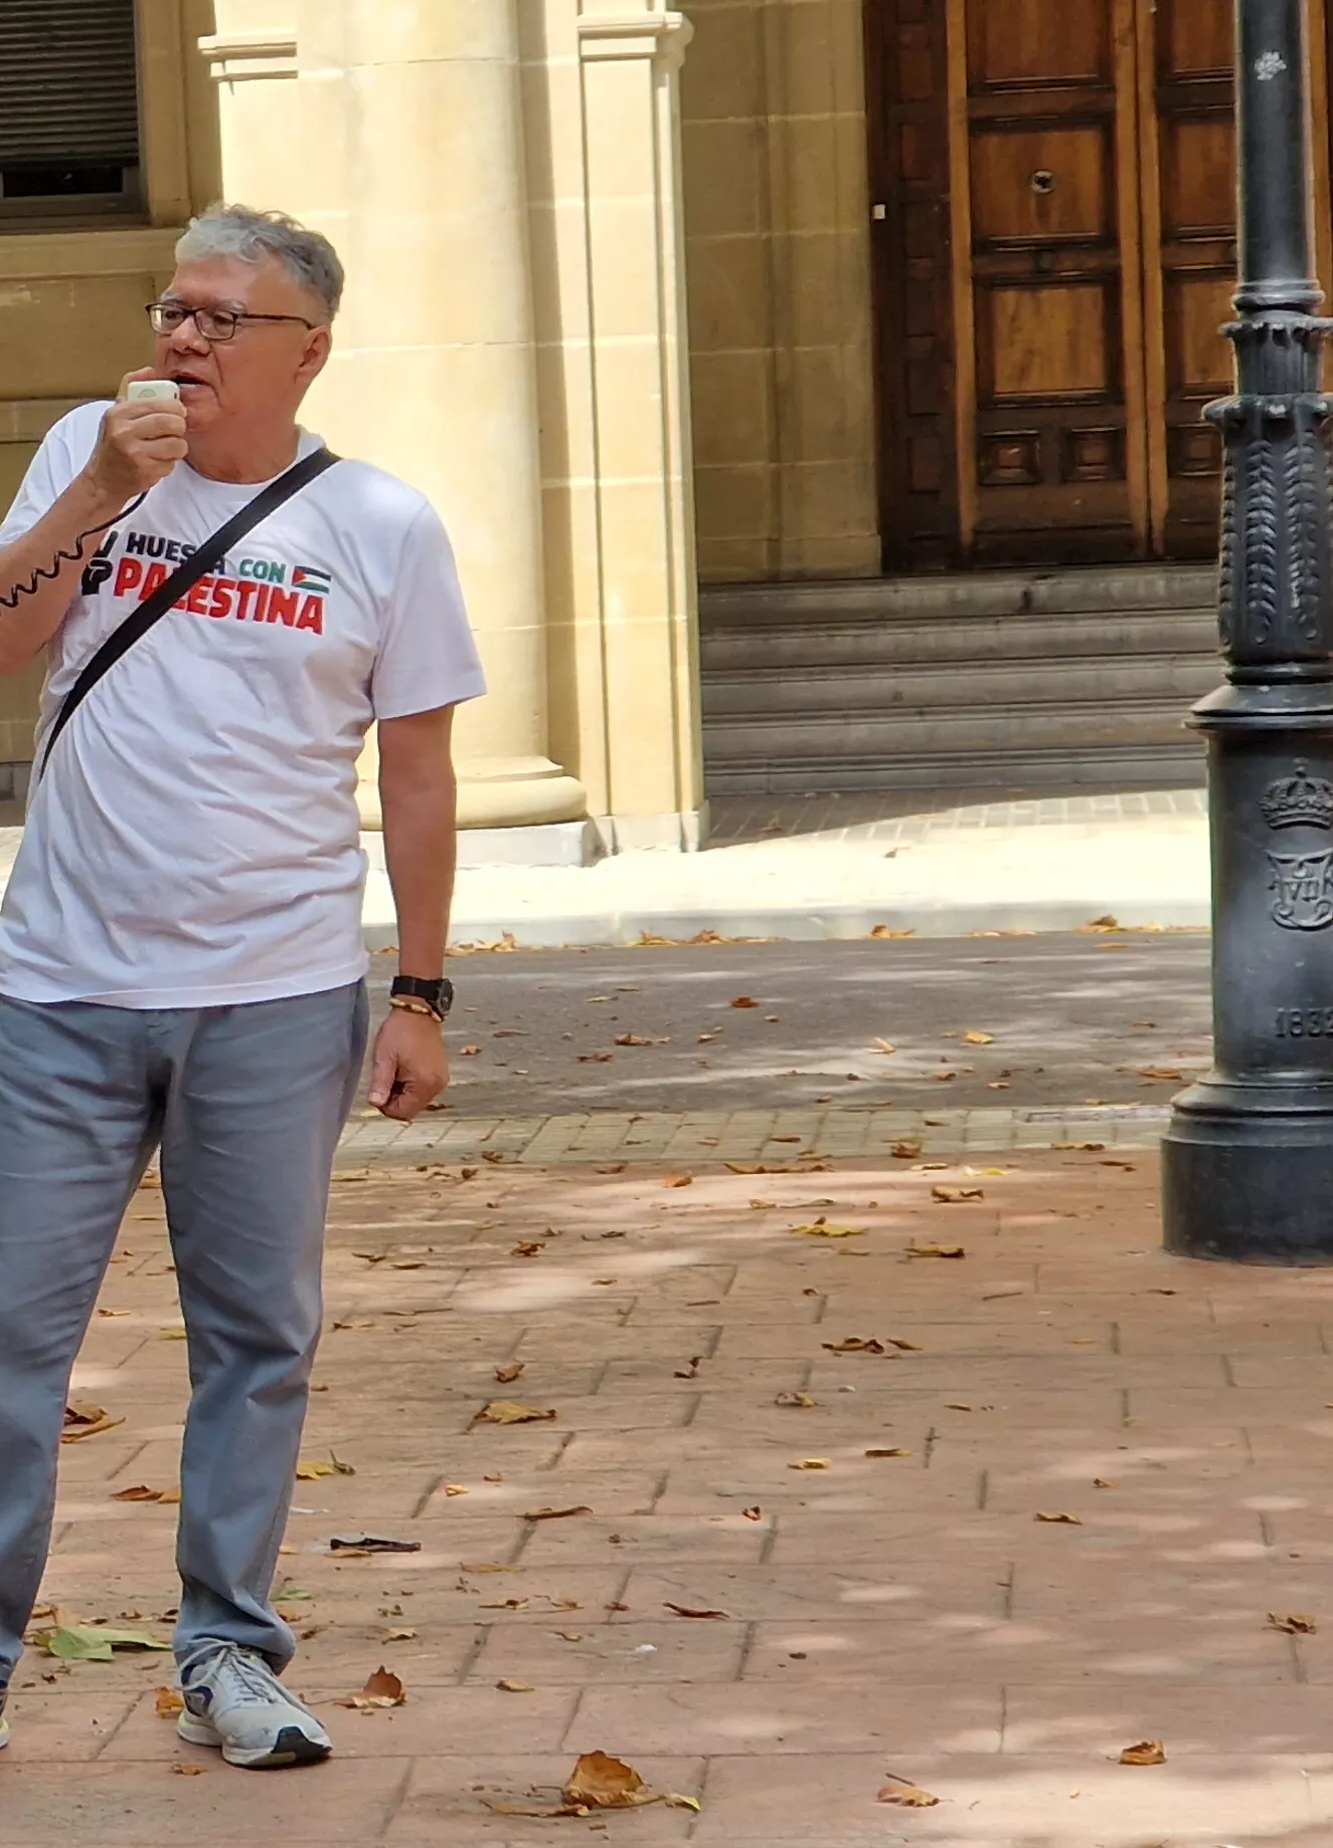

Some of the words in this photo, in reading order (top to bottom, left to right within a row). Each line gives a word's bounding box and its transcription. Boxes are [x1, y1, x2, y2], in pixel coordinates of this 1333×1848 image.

[125, 531, 226, 576] HUESA
[238, 558, 286, 583] CON
[113, 556, 324, 635] PAESTINA
